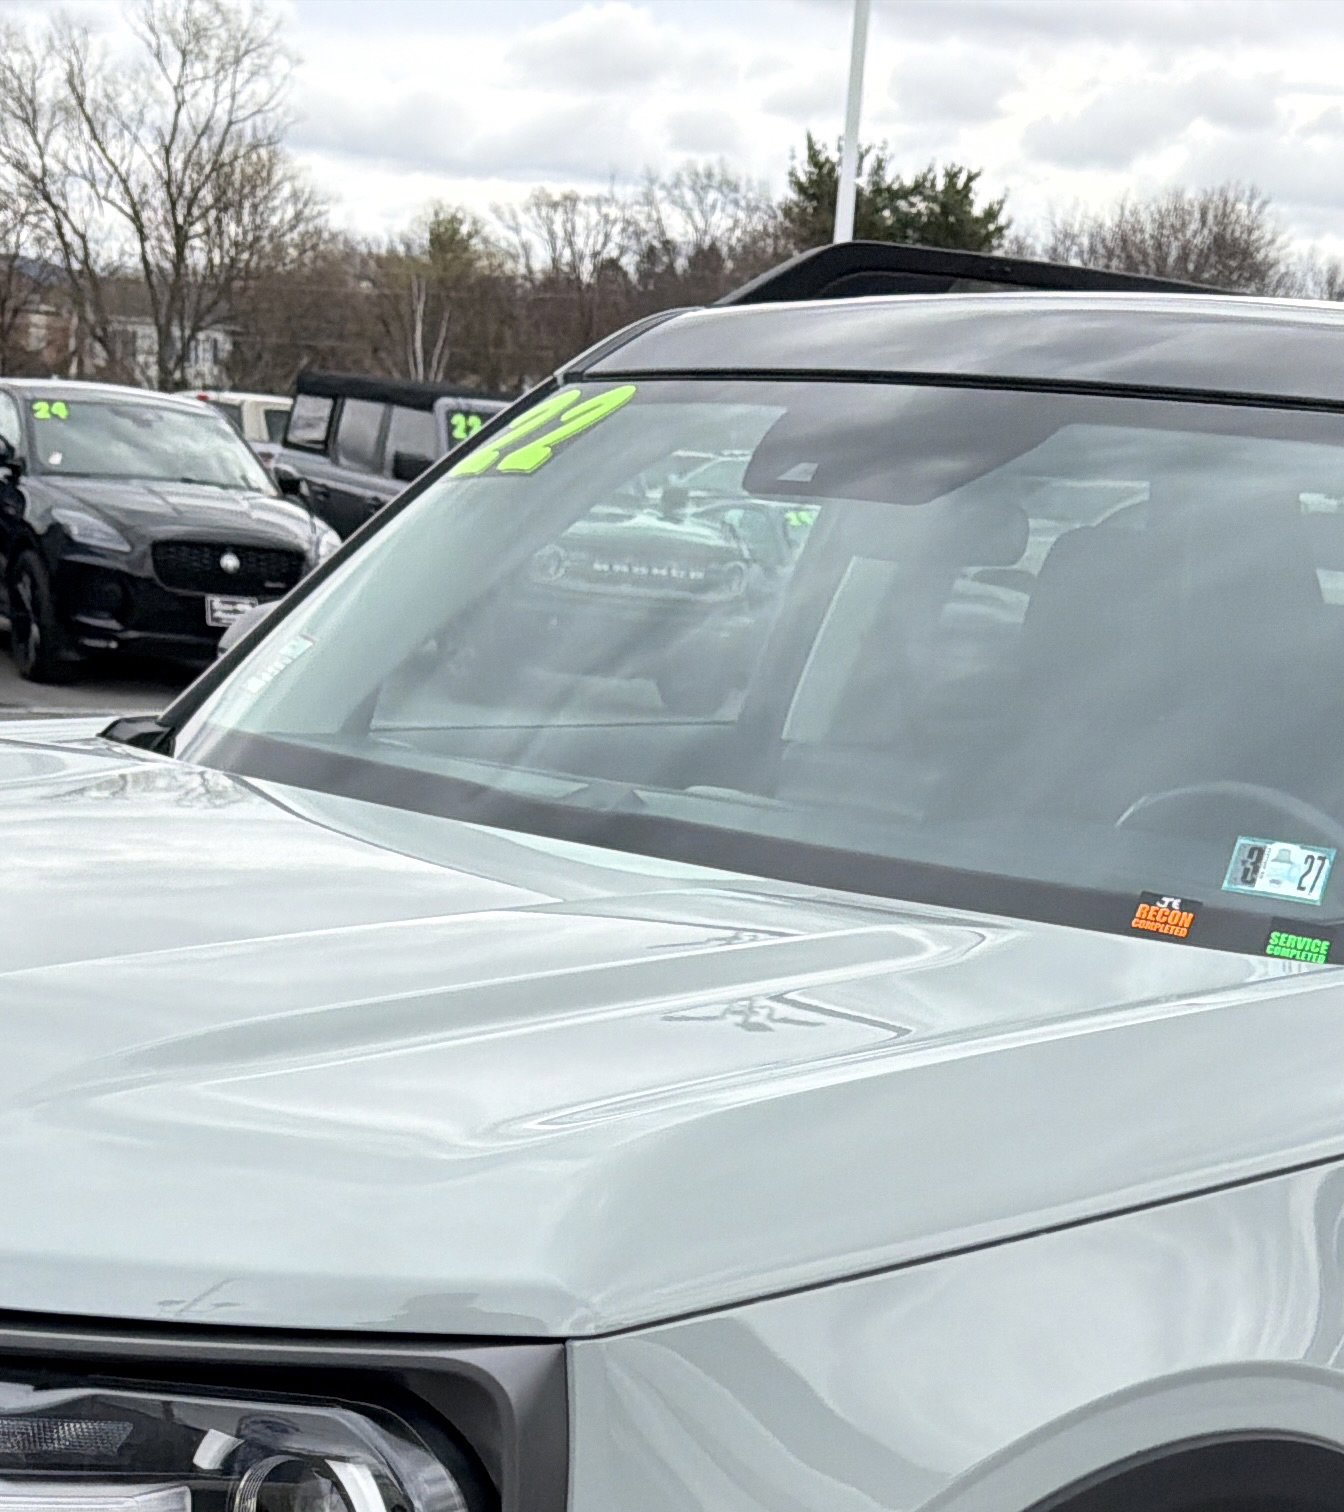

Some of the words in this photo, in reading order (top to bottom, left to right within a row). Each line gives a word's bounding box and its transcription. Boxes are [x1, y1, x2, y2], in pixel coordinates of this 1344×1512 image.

[31, 401, 68, 420] 24
[448, 384, 637, 475] 22
[1296, 854, 1328, 896] 27
[1135, 903, 1195, 928] RECON
[1131, 918, 1189, 938] COMPLETED
[1265, 944, 1327, 964] COMPLETED
[1269, 931, 1331, 955] SERVICE
